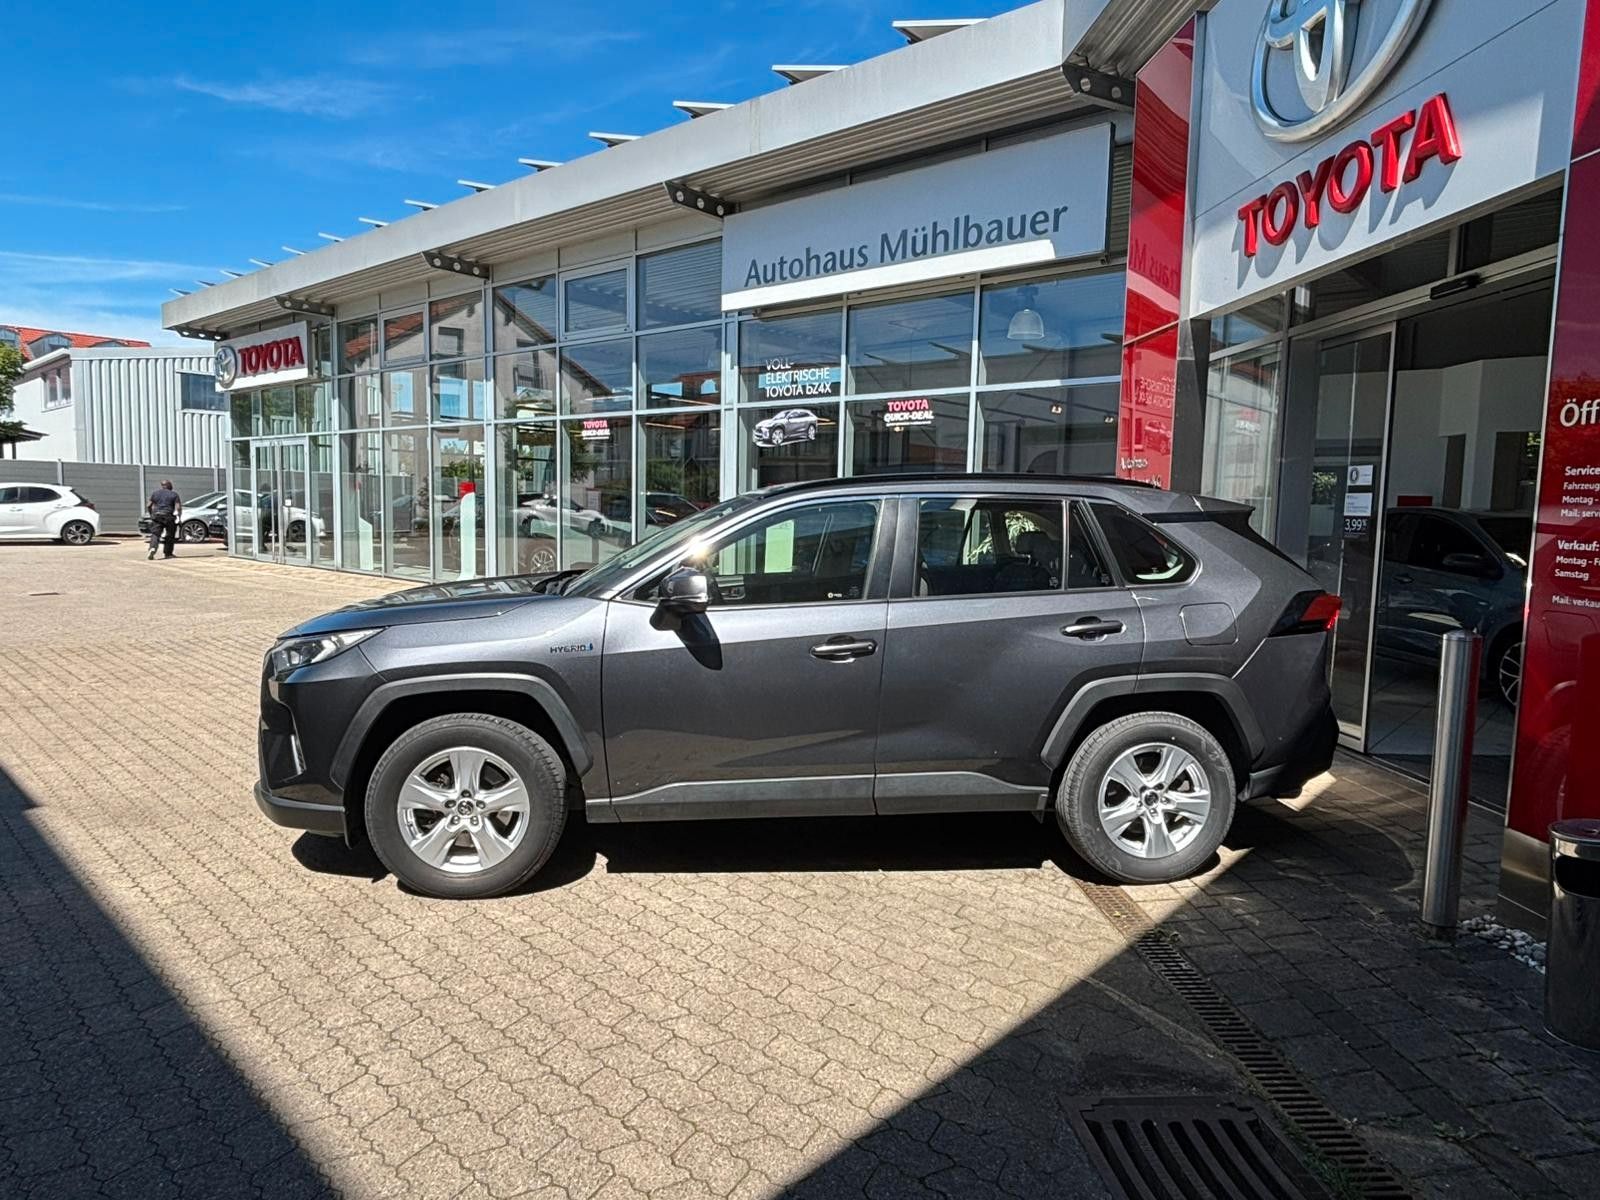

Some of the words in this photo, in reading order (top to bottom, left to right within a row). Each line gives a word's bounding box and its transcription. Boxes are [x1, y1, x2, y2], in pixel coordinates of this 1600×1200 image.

[1238, 92, 1462, 258] TOYOTA
[744, 243, 869, 288] Autohaus
[880, 205, 1068, 264] Mühlbauer
[238, 335, 305, 374] TOYOTA
[765, 357, 795, 371] VOLL-
[765, 367, 831, 385] ELEKTRISCHE
[765, 384, 804, 398] TOYOTA
[805, 381, 832, 395] bZ4X
[887, 399, 929, 412] TOYOTA
[883, 410, 935, 423] QUICK-DEAL
[583, 420, 608, 429] TOYOTA
[1562, 495, 1594, 506] Montag
[1557, 539, 1600, 552] Verkauf:
[1556, 555, 1587, 568] Montag
[1554, 568, 1589, 581] Samstag
[550, 644, 587, 654] HYBRID
